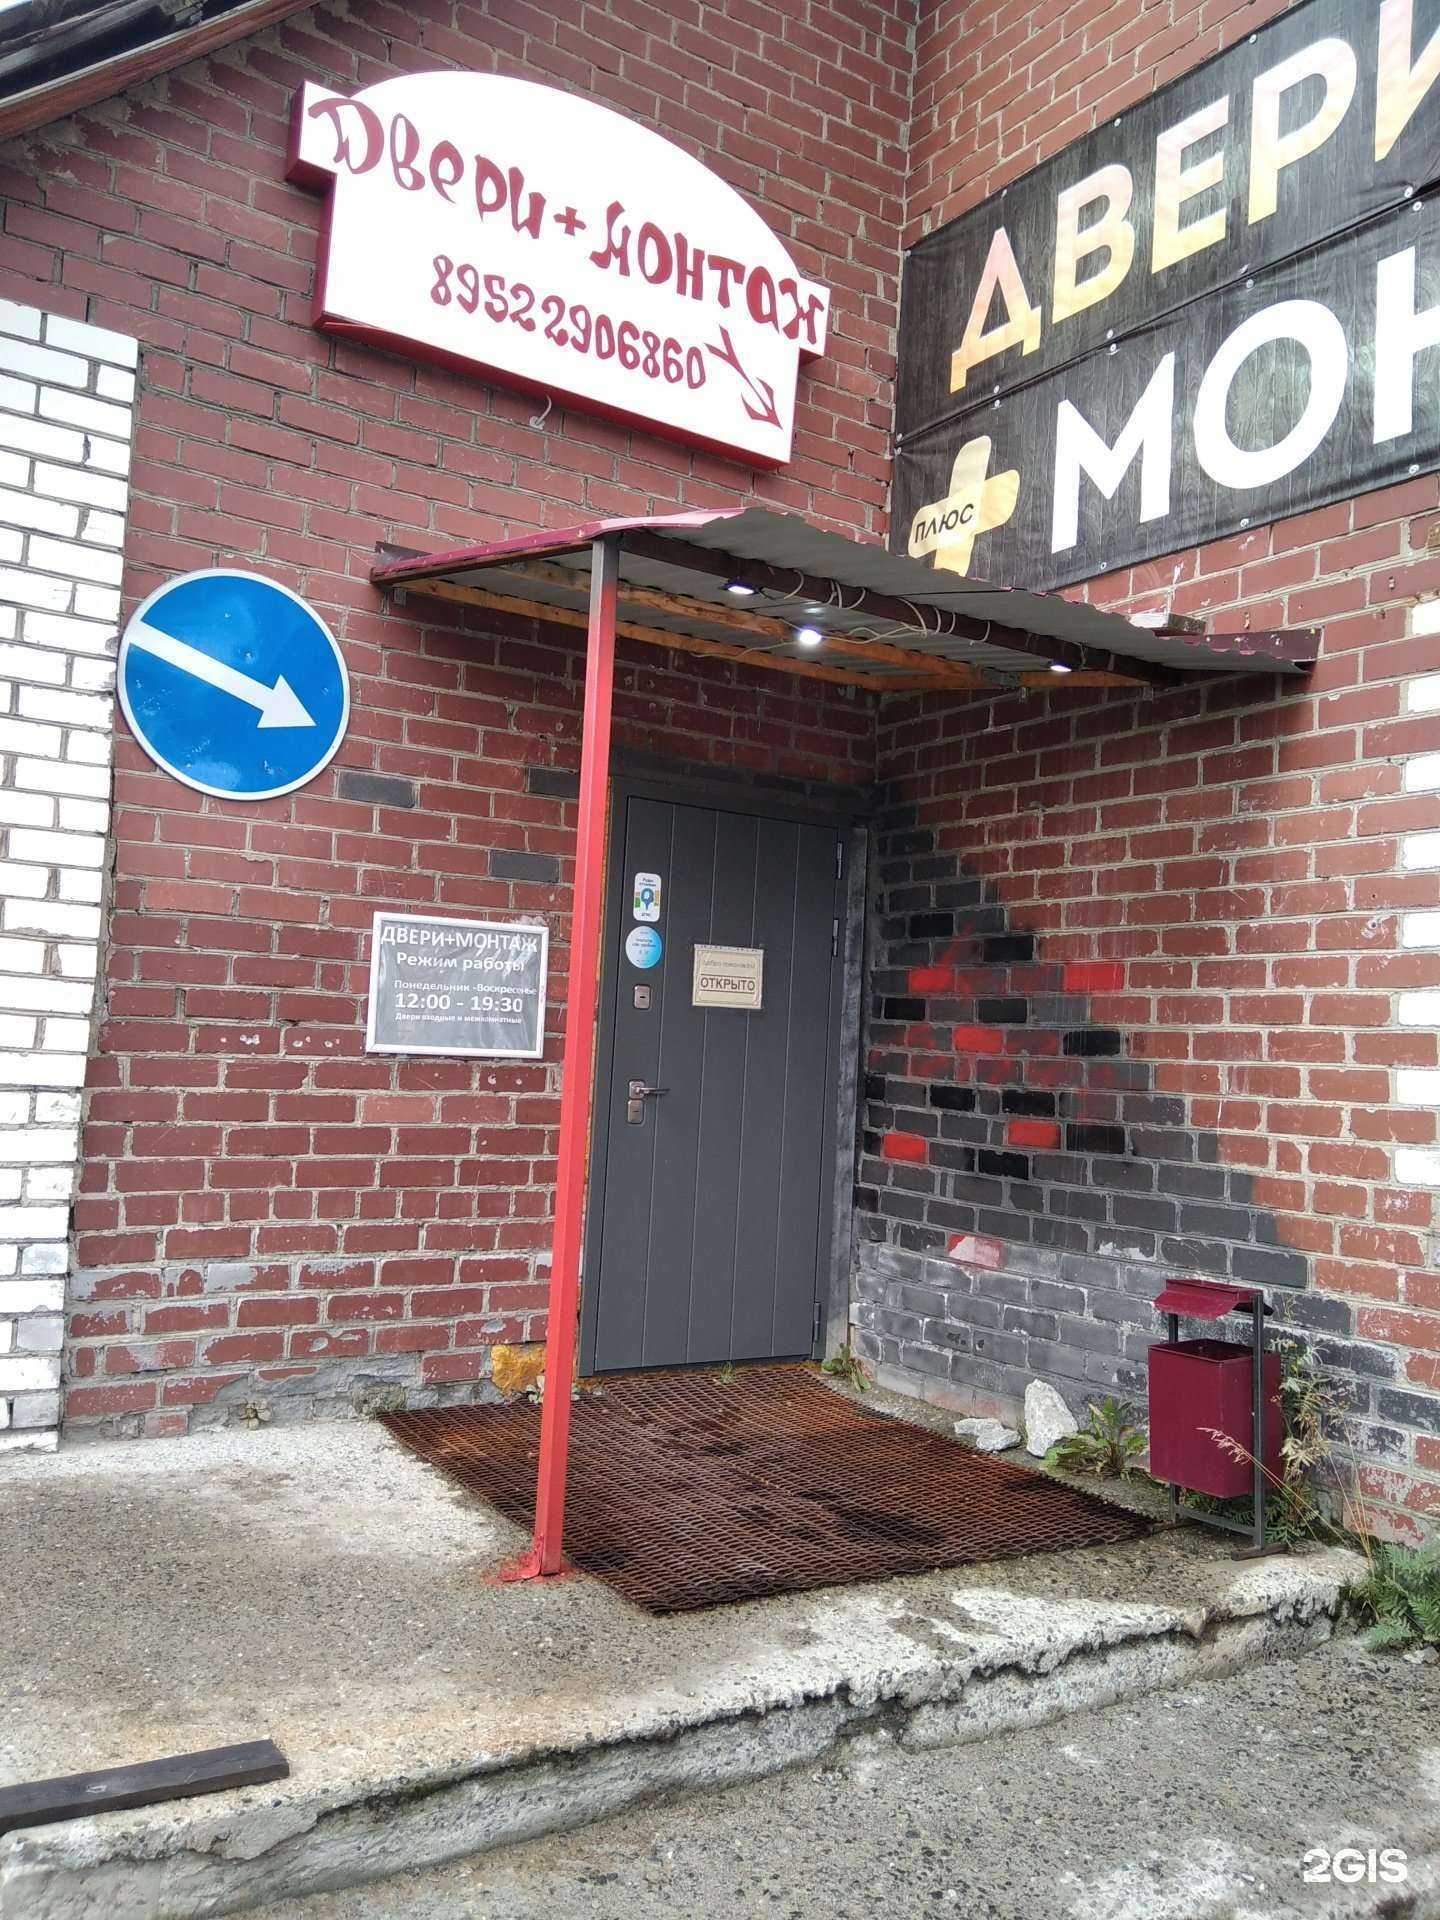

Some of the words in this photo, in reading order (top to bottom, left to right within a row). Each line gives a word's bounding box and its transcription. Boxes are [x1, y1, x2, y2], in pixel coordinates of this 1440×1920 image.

[430, 254, 706, 389] 89522906860
[915, 503, 974, 543] ПЛЮС
[396, 952, 458, 968] Режим
[463, 957, 524, 972] работы
[394, 979, 470, 993] Понедельник
[700, 976, 756, 991] ОТКРЫТО
[395, 993, 451, 1010] 12:00
[470, 996, 523, 1013] 19:30
